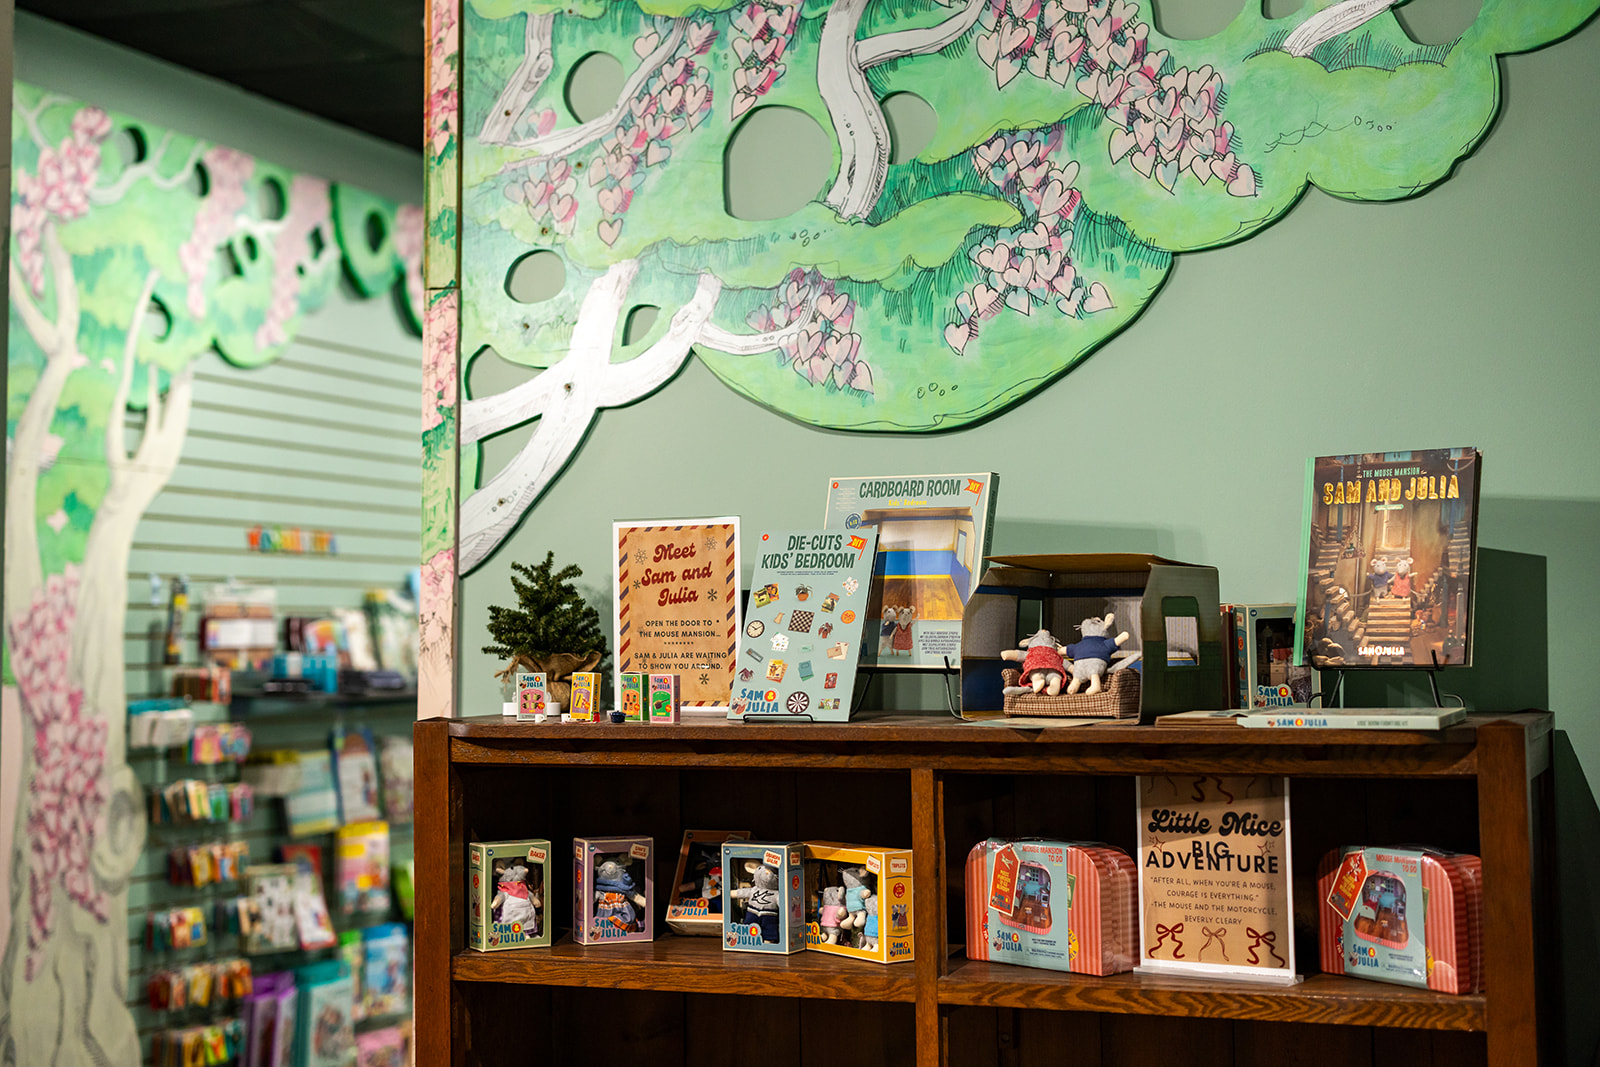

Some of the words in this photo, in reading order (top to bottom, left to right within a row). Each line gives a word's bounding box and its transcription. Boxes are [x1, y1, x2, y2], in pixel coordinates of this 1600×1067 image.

[1363, 470, 1372, 478] THE
[1374, 468, 1393, 477] MOUSE
[1394, 467, 1420, 476] MANSION
[859, 480, 924, 498] CARDBOARD
[926, 479, 961, 497] ROOM
[1323, 480, 1362, 505] SAM
[1366, 478, 1402, 502] AND
[1405, 475, 1460, 500] JULIA
[787, 534, 843, 551] DIE-CUTS
[652, 542, 696, 563] Meet
[761, 552, 793, 569] KIDS'
[795, 553, 856, 569] BEDROOM
[641, 568, 677, 586] Sam
[681, 561, 713, 582] and
[657, 587, 699, 607] Julia
[740, 688, 763, 701] SAM
[1258, 687, 1278, 697] SAM
[745, 702, 778, 713] JULIA
[1266, 697, 1293, 707] JULIA
[1304, 719, 1328, 727] JULIA
[1148, 809, 1212, 834] Little
[1218, 812, 1283, 836] Mice
[530, 850, 545, 859] BAKER
[1192, 840, 1230, 860] BIG
[1146, 851, 1279, 874] ADVENTURE
[1216, 880, 1240, 888] YOU'RE
[1167, 890, 1198, 898] COURAGE
[1169, 902, 1192, 910] MOUSE
[682, 908, 708, 916] JULIA
[595, 919, 613, 928] SAM
[1185, 915, 1213, 923] BEVERLY
[493, 923, 512, 933] SAM
[601, 929, 627, 938] JULIA
[731, 924, 748, 935] SAM
[499, 932, 525, 944] JULIA
[737, 936, 762, 946] JULIA
[807, 934, 821, 944] ULIA
[997, 930, 1012, 942] SAM
[1002, 942, 1023, 952] JULIA
[1353, 944, 1368, 956] SAM
[1358, 956, 1379, 968] JULIA
